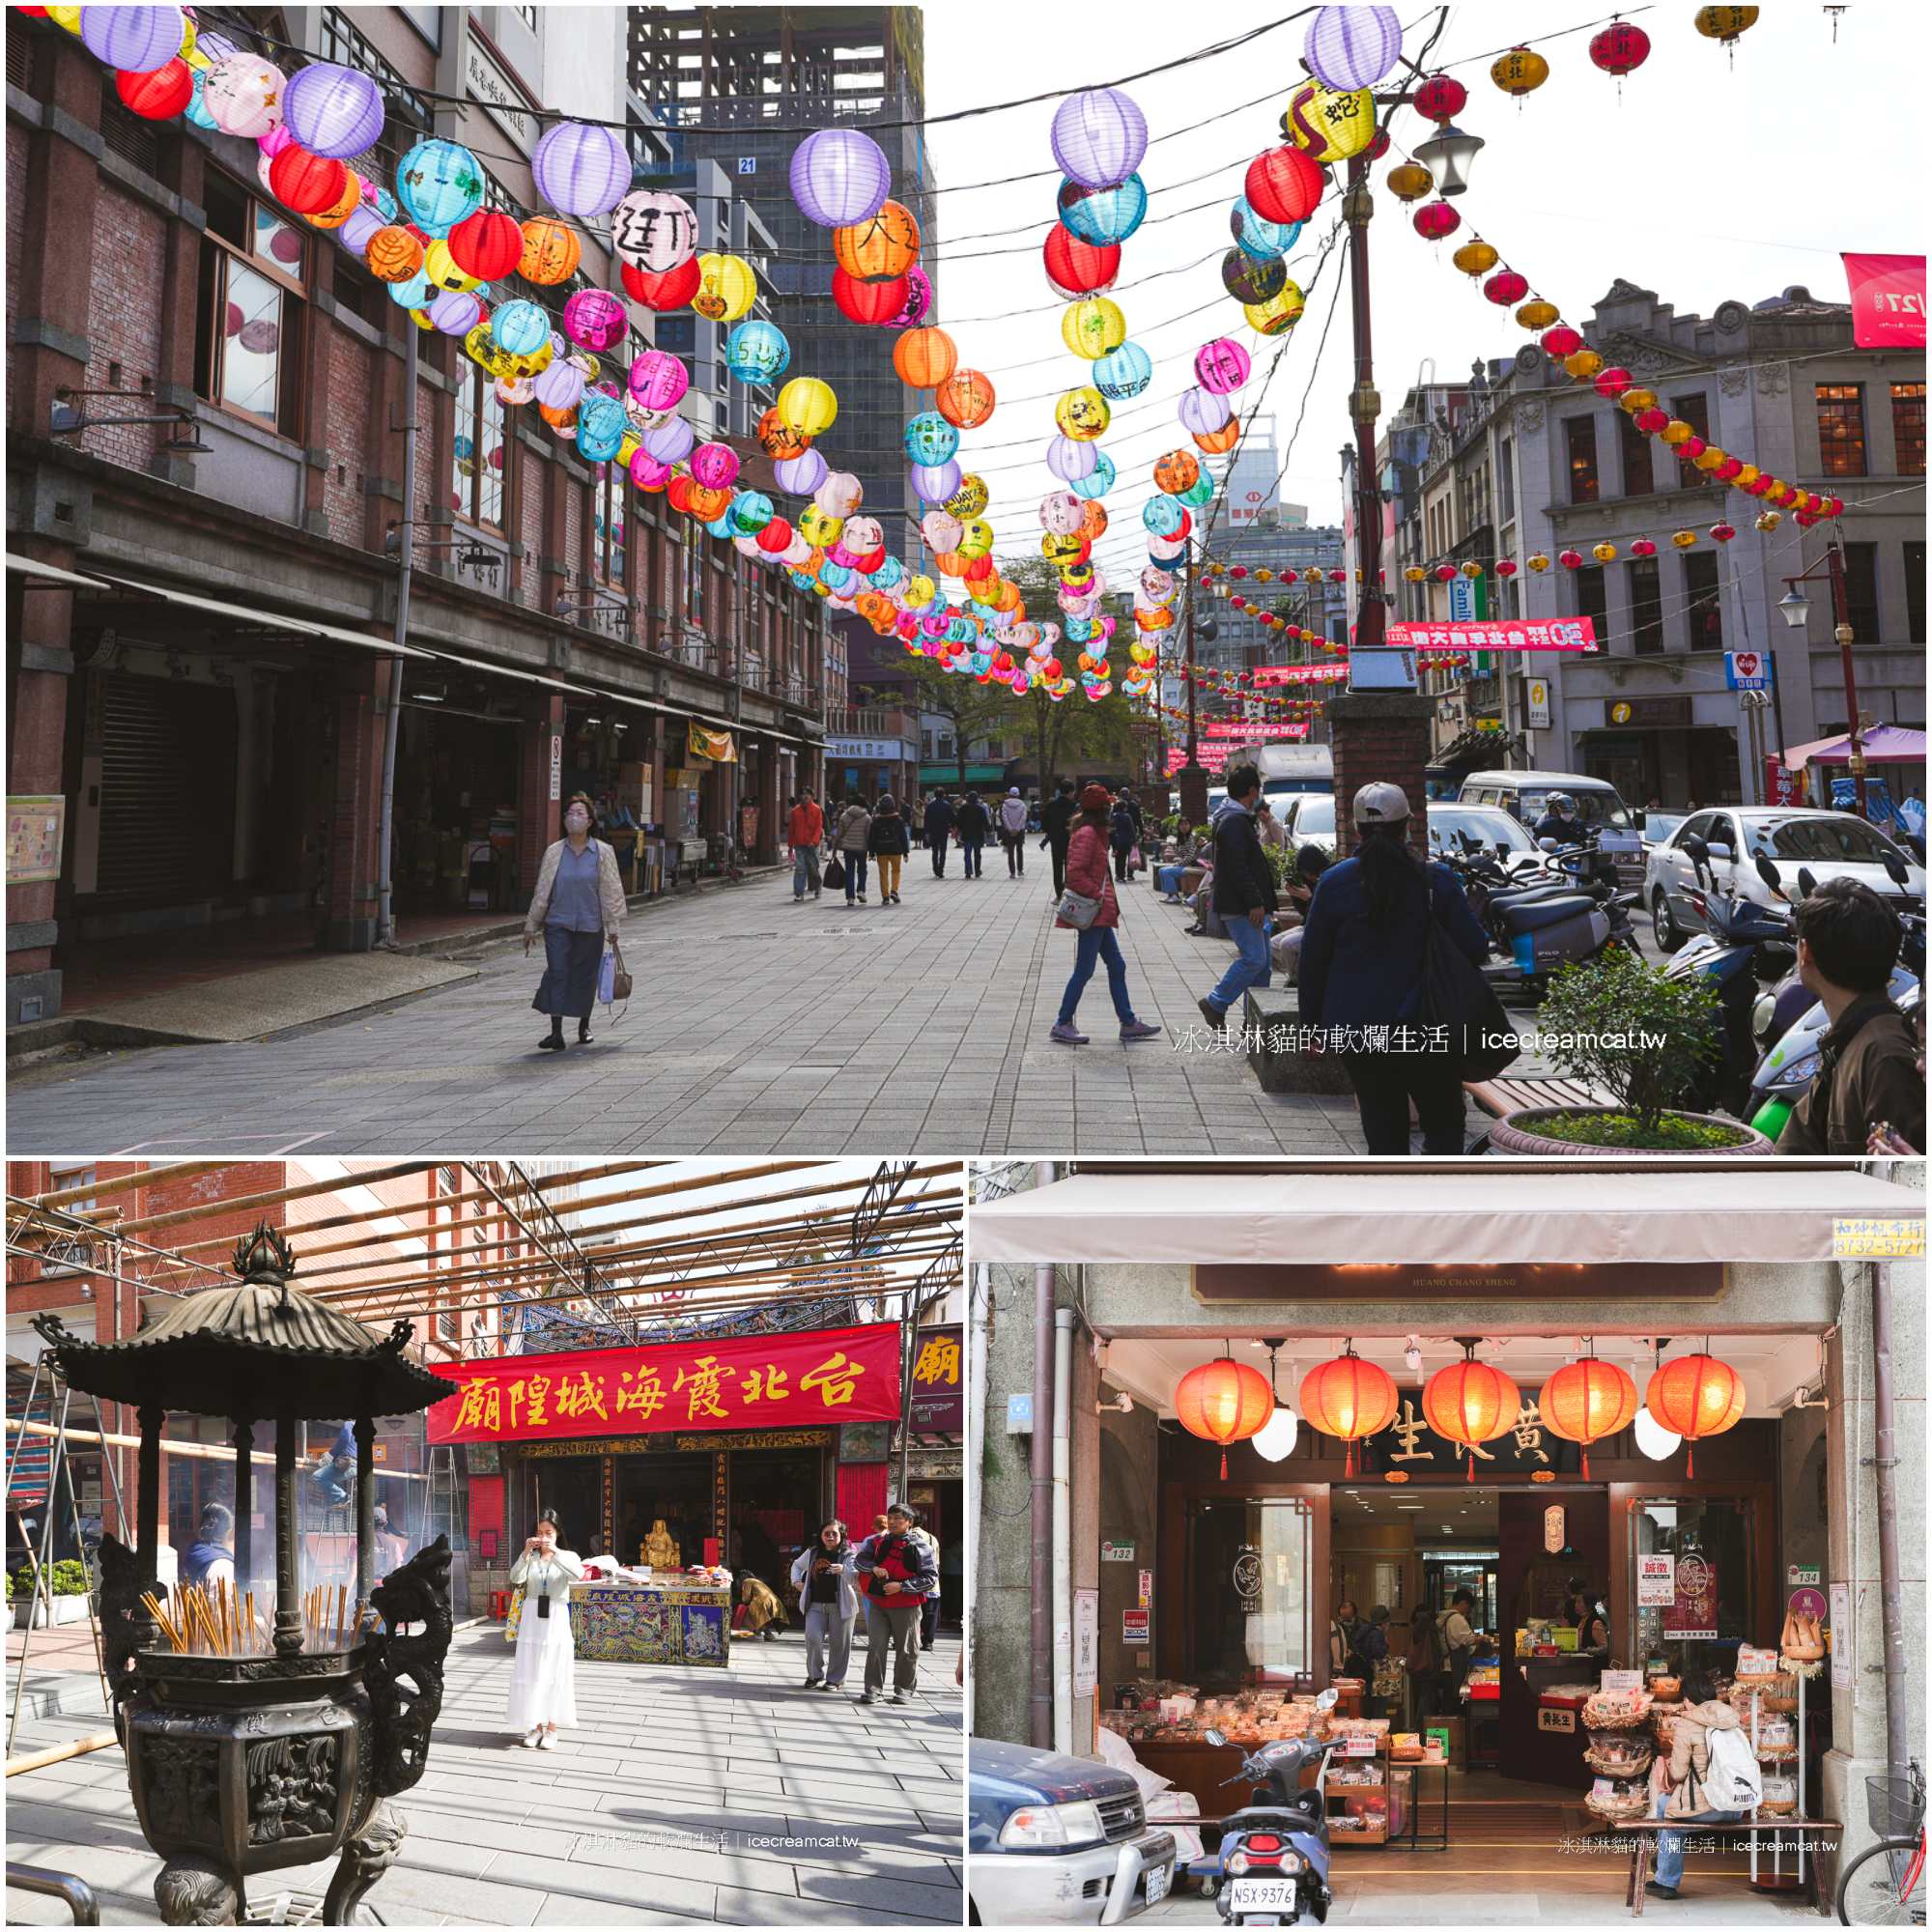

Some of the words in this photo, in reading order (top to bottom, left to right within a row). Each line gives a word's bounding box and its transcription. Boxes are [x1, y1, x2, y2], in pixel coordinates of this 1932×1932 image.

[1509, 54, 1523, 79] 台北
[1324, 95, 1359, 126] 蛇
[741, 159, 754, 172] 21
[914, 1336, 960, 1385] 廟
[1390, 1399, 1549, 1463] 黃生
[1114, 1549, 1131, 1559] 132
[1800, 1573, 1816, 1582] 134
